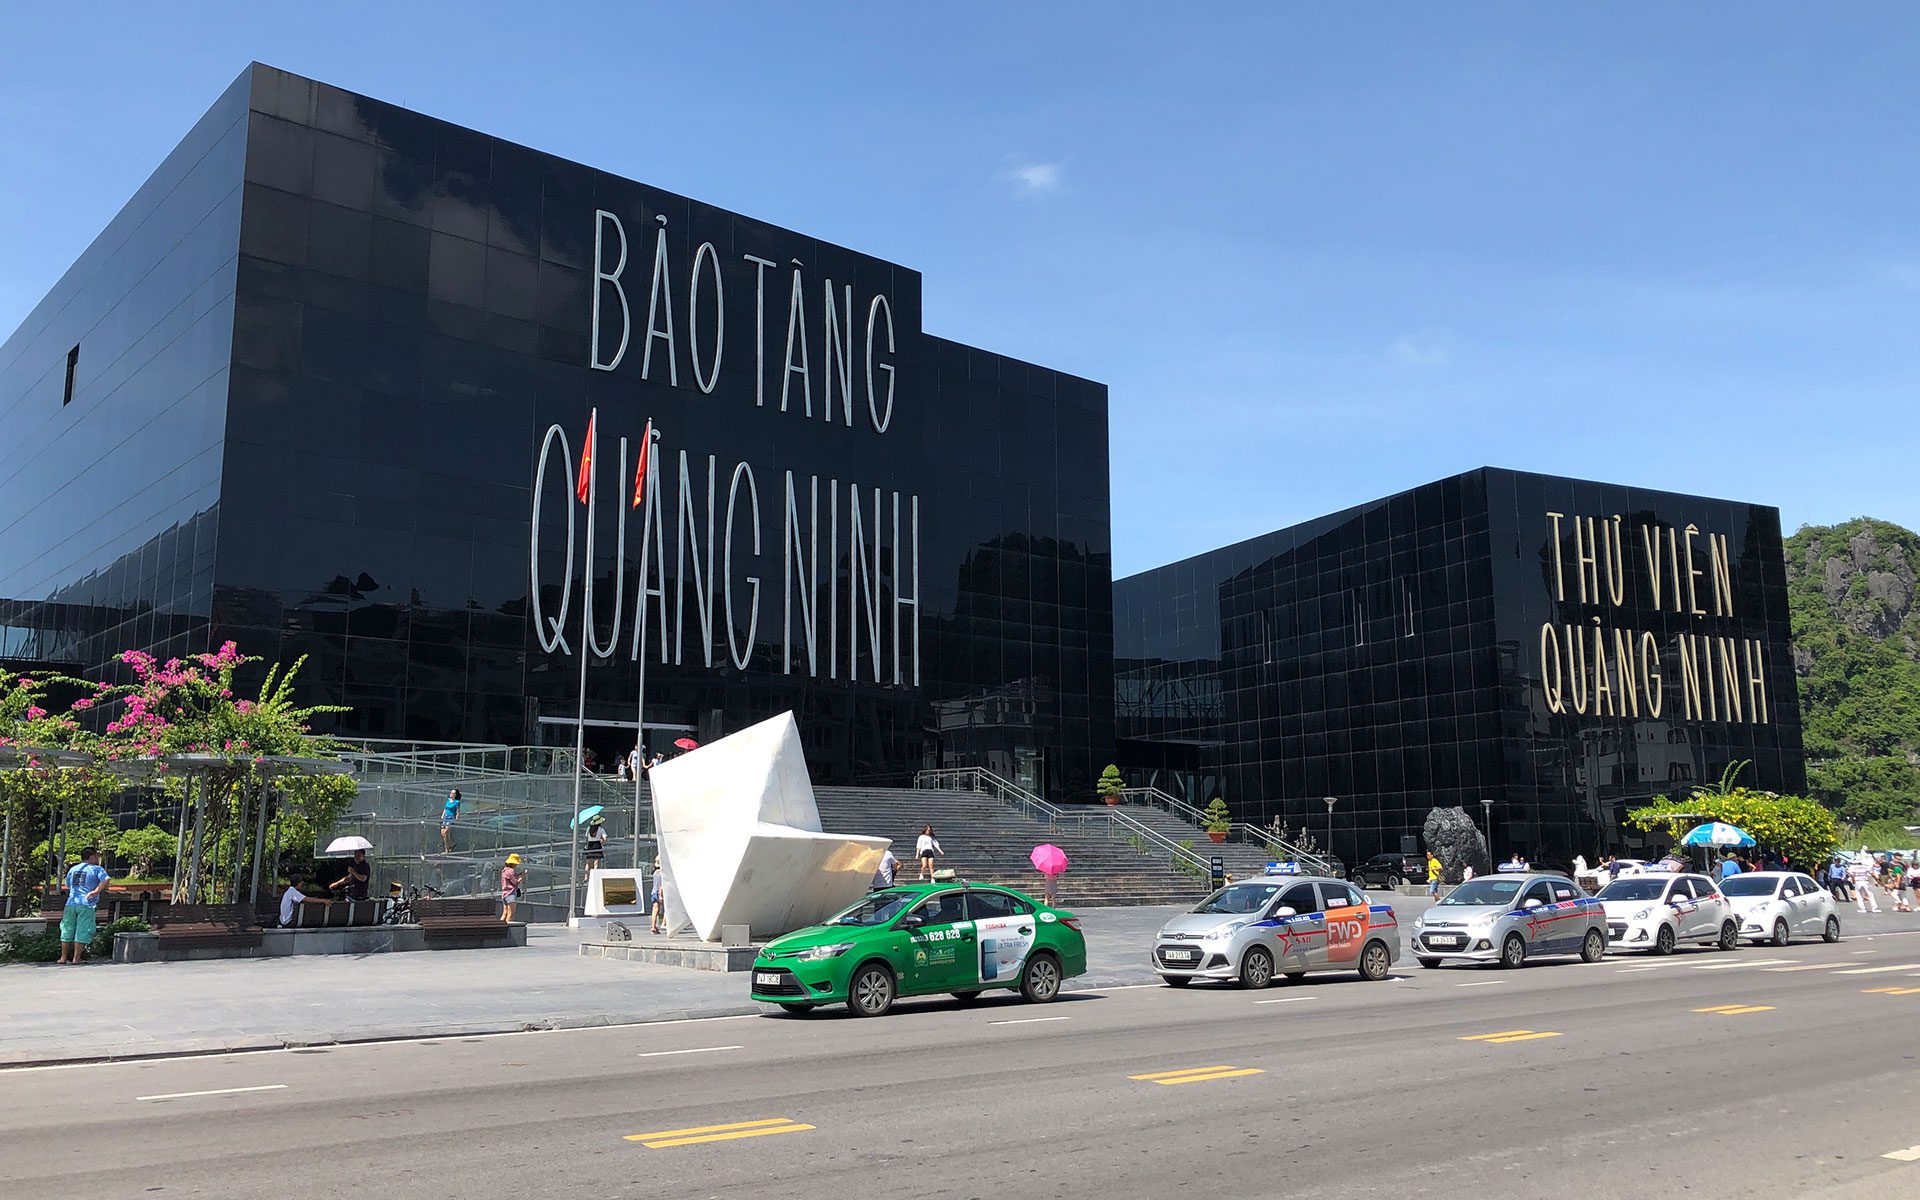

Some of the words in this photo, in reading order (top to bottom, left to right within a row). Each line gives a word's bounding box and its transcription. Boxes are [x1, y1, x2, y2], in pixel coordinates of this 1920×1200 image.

[591, 209, 724, 394] BẢO
[744, 254, 895, 434] TÀNG
[531, 423, 760, 671] QUẢNG
[784, 470, 919, 687] NINH
[1546, 511, 1623, 607] THƯ
[1642, 523, 1733, 619] VIỆN
[1541, 616, 1662, 719] QUẢNG
[1678, 633, 1768, 725] NINH
[930, 931, 944, 941] 628
[946, 929, 960, 939] 628
[1328, 920, 1362, 940] FWD
